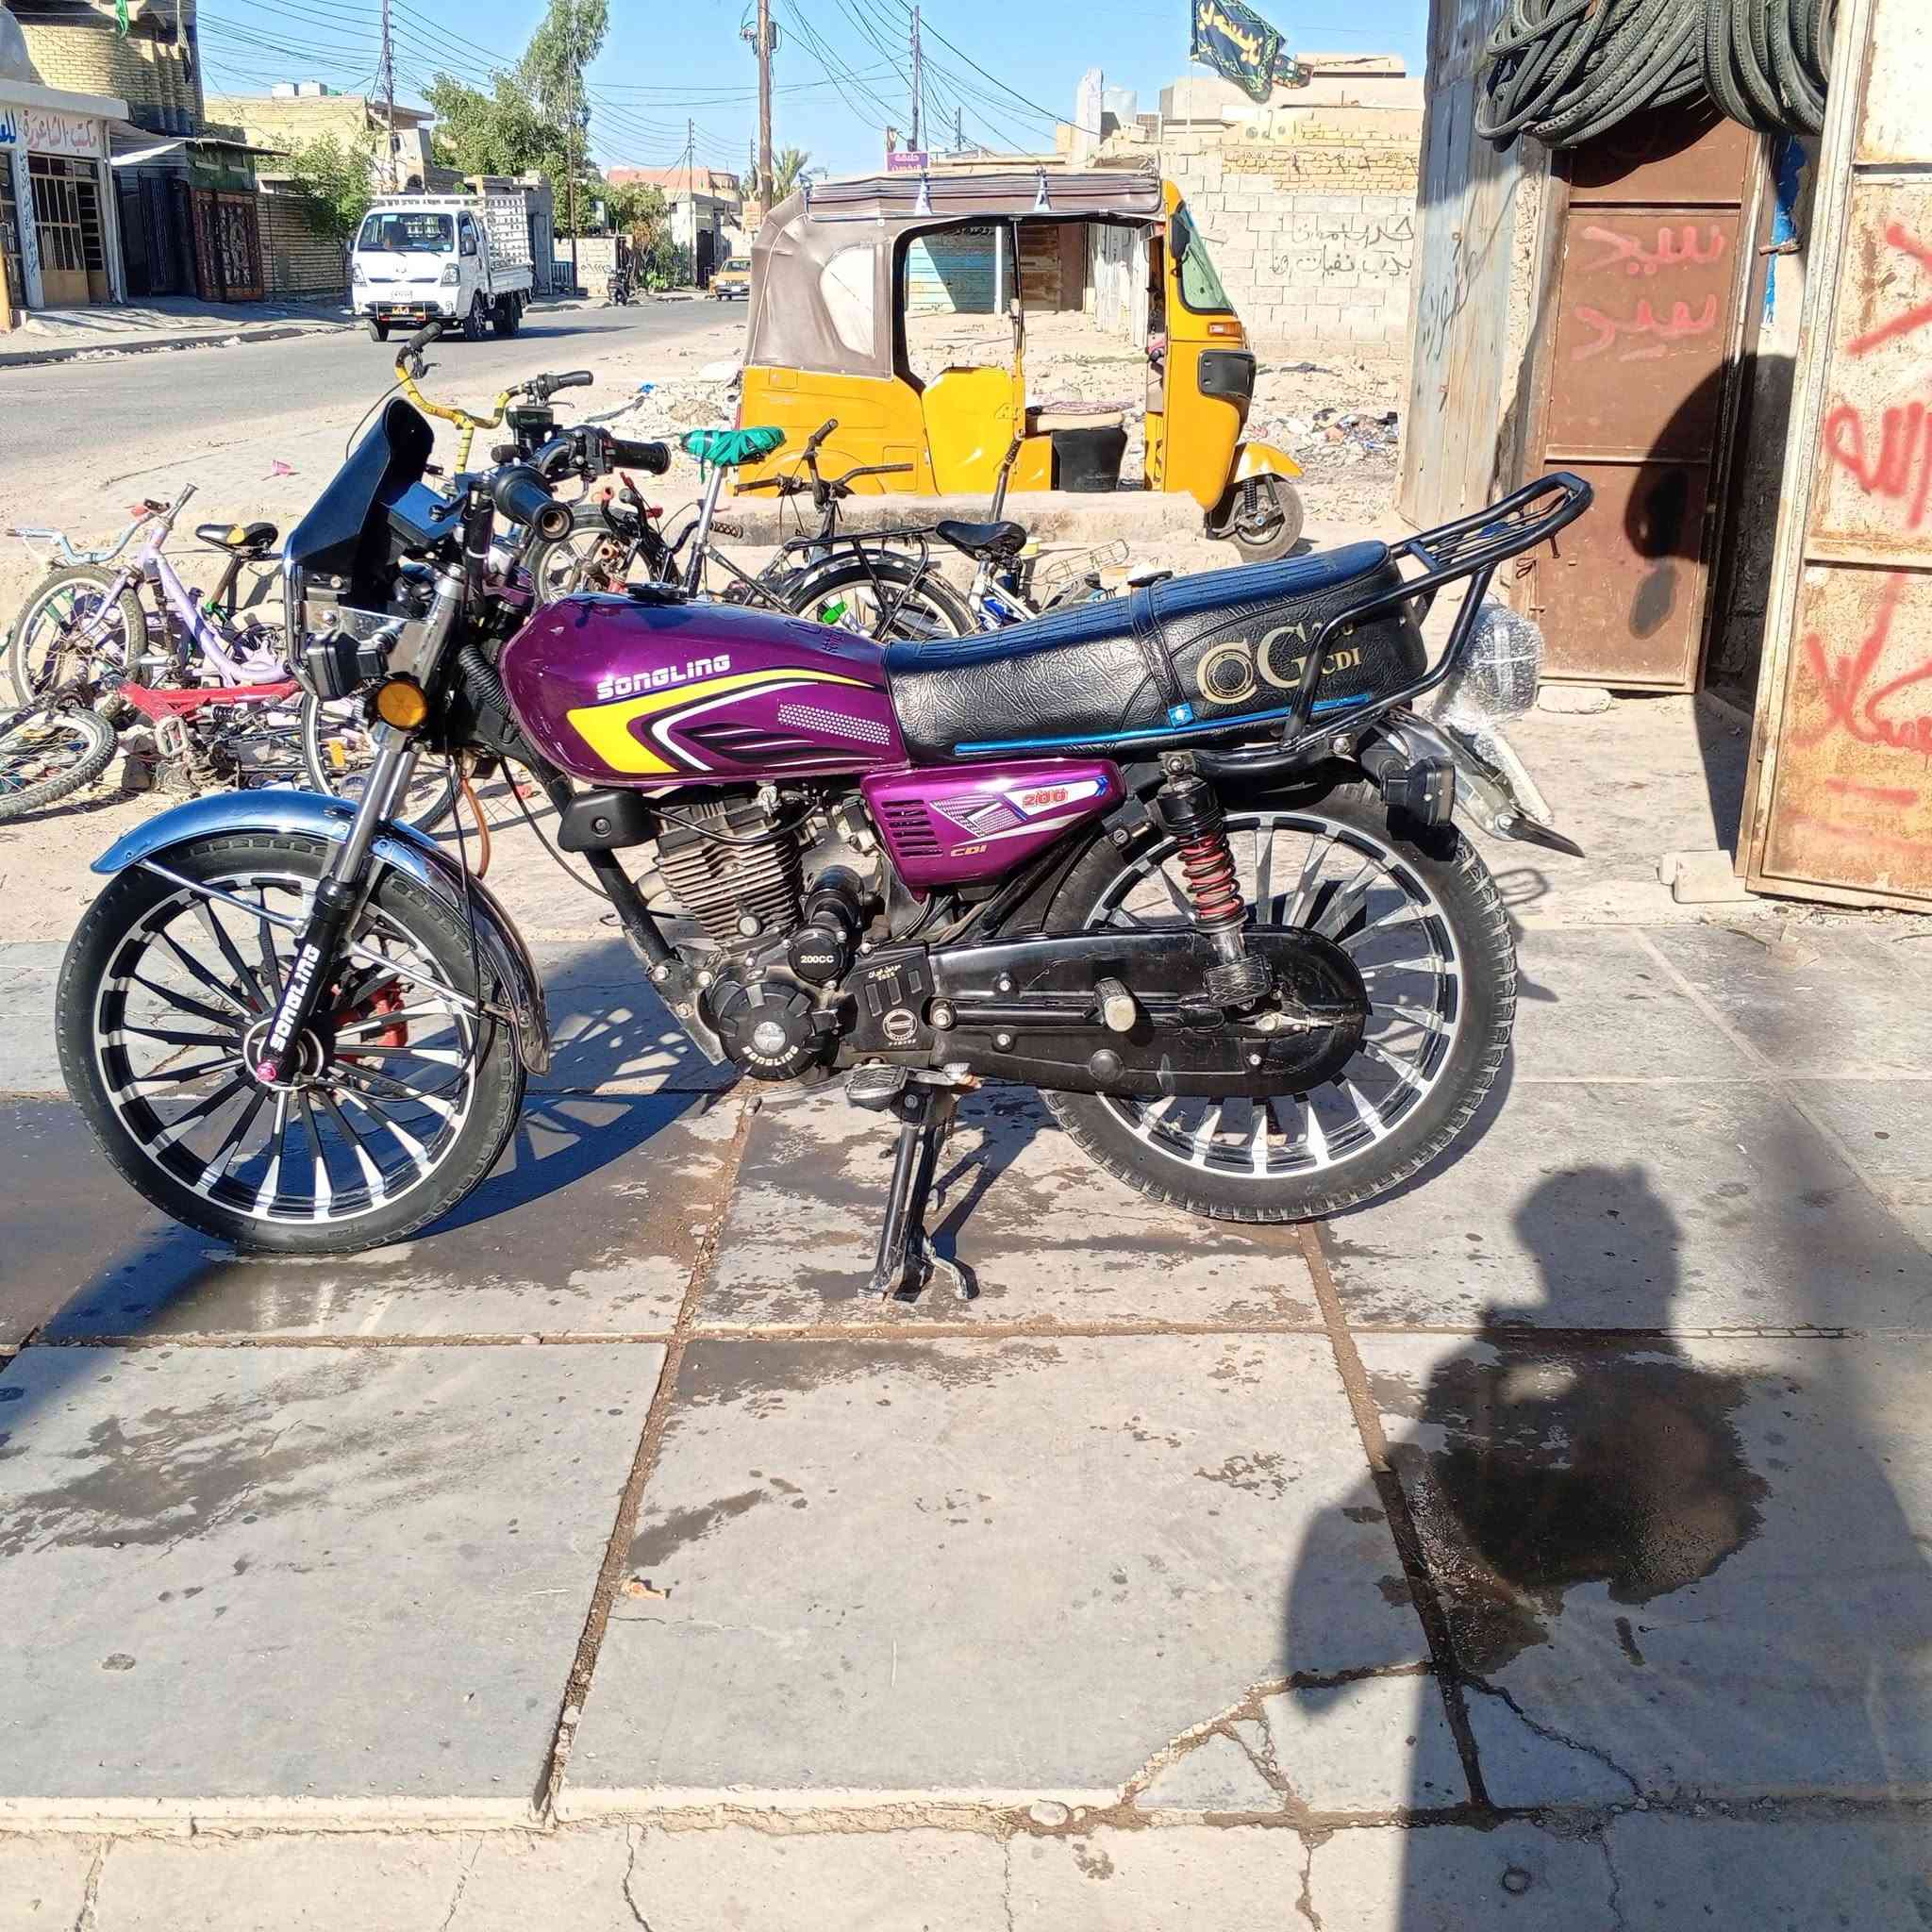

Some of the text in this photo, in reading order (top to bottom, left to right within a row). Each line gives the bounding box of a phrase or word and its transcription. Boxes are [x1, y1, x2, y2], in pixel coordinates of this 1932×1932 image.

[1022, 788, 1069, 808] 200
[951, 844, 988, 858] CDI
[800, 955, 835, 964] 200CC
